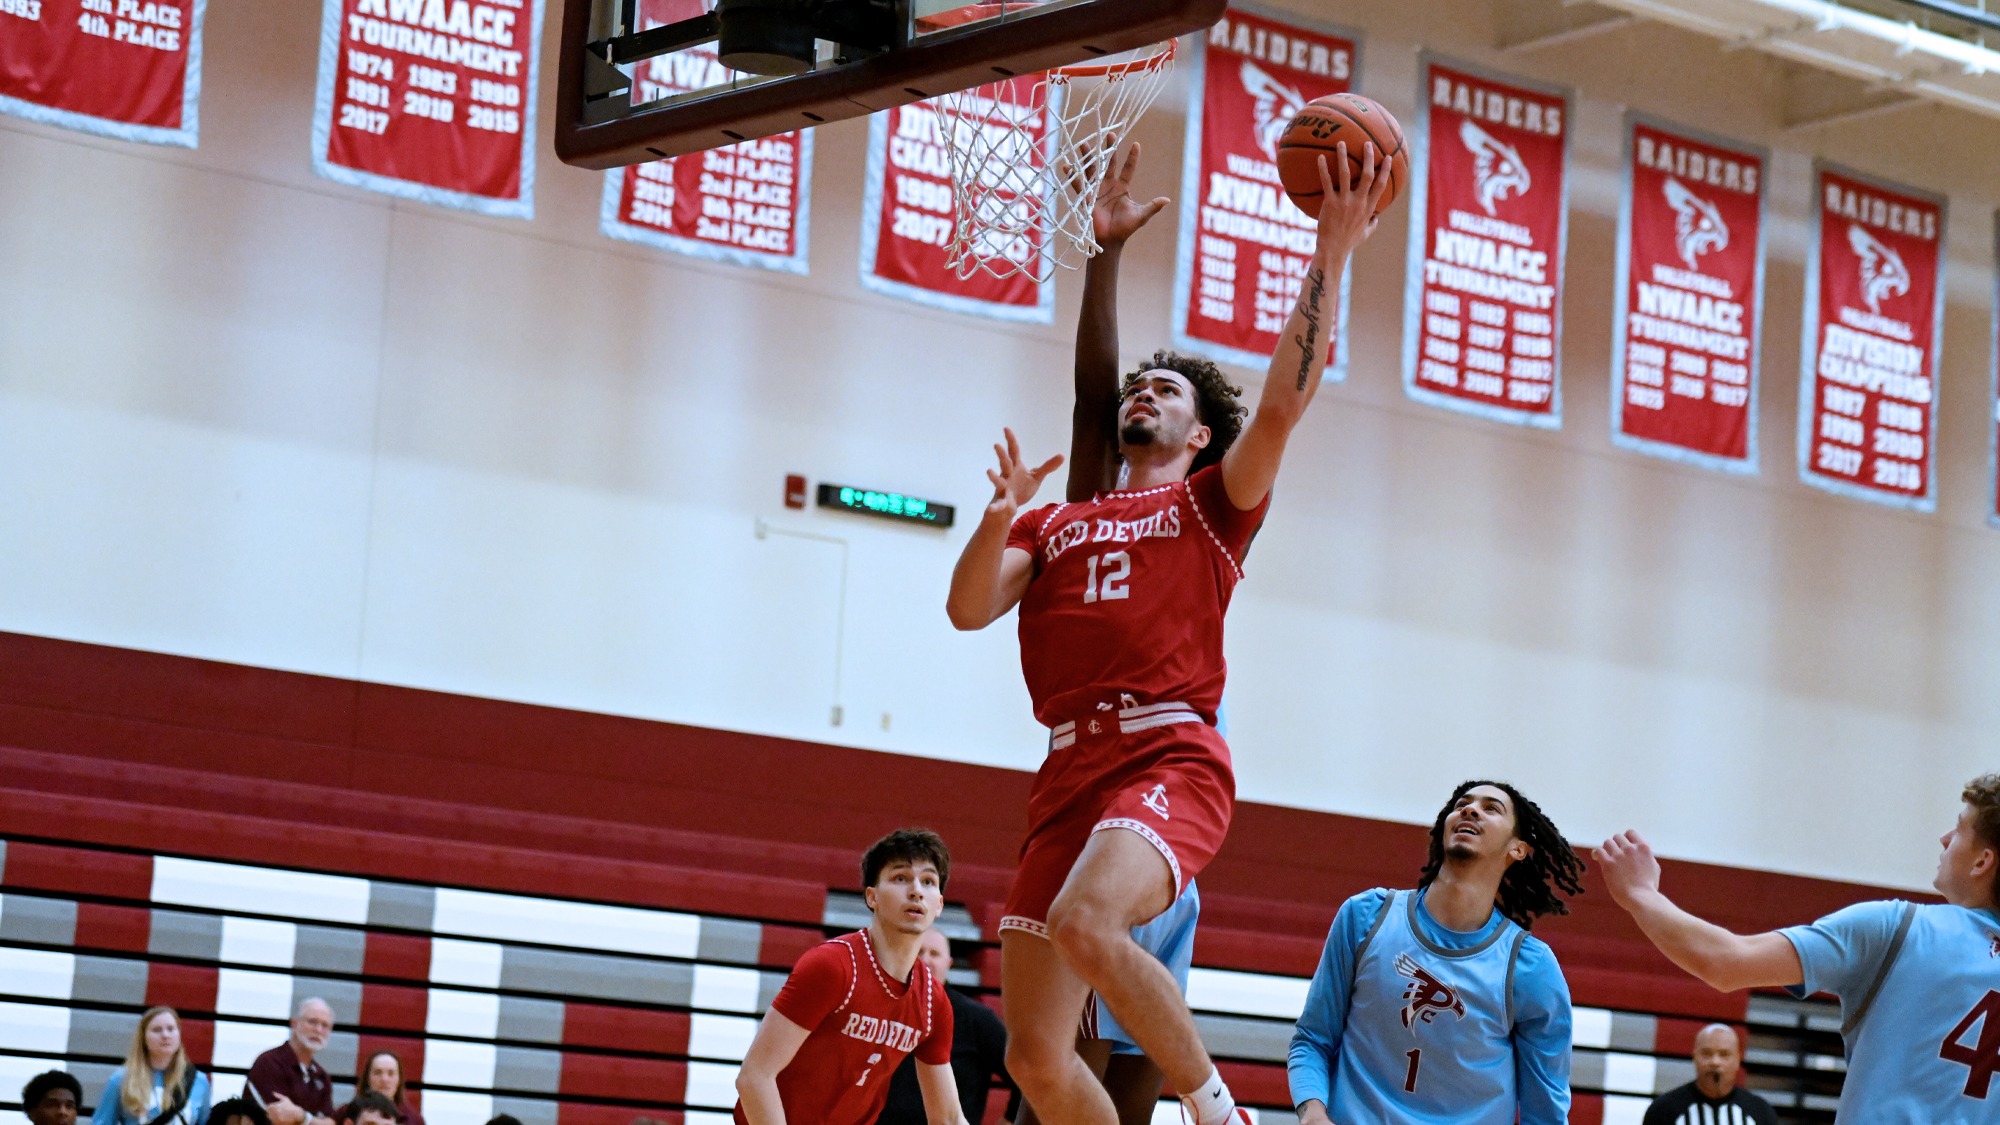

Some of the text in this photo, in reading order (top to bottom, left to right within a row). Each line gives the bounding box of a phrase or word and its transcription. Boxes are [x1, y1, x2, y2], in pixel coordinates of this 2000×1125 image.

[0, 0, 42, 21] 993
[77, 12, 181, 51] 4th PLACE
[117, 0, 182, 28] PLACE
[347, 49, 395, 82] 1974
[348, 14, 523, 77] TOURNAMENT
[1209, 17, 1350, 81] RAIDERS
[338, 103, 390, 136] 2017
[346, 76, 520, 134] 1991 2010 2015
[1432, 76, 1561, 136] RAIDERS
[700, 171, 733, 196] 2nd
[734, 179, 792, 207] PLACE
[703, 150, 794, 184] 3rd PLACE
[1637, 136, 1758, 195] RAIDERS
[733, 201, 792, 230] PLACE
[1207, 171, 1318, 232] NWAA
[1825, 182, 1936, 241] RAIDERS
[696, 217, 732, 241] 2nd
[731, 224, 790, 251] PLACE
[1202, 205, 1318, 255] TOURNAME
[1434, 227, 1547, 283] NWAACC
[1425, 258, 1555, 309] TOURNAMENT
[1637, 281, 1744, 336] NWAACC
[1629, 312, 1750, 361] TOURNAMENT
[1045, 505, 1181, 562] RED DEVILS
[1083, 550, 1131, 604] 12
[841, 1012, 922, 1053] RED DEVILS
[1938, 988, 2000, 1100] 4
[1403, 1048, 1422, 1094] 1
